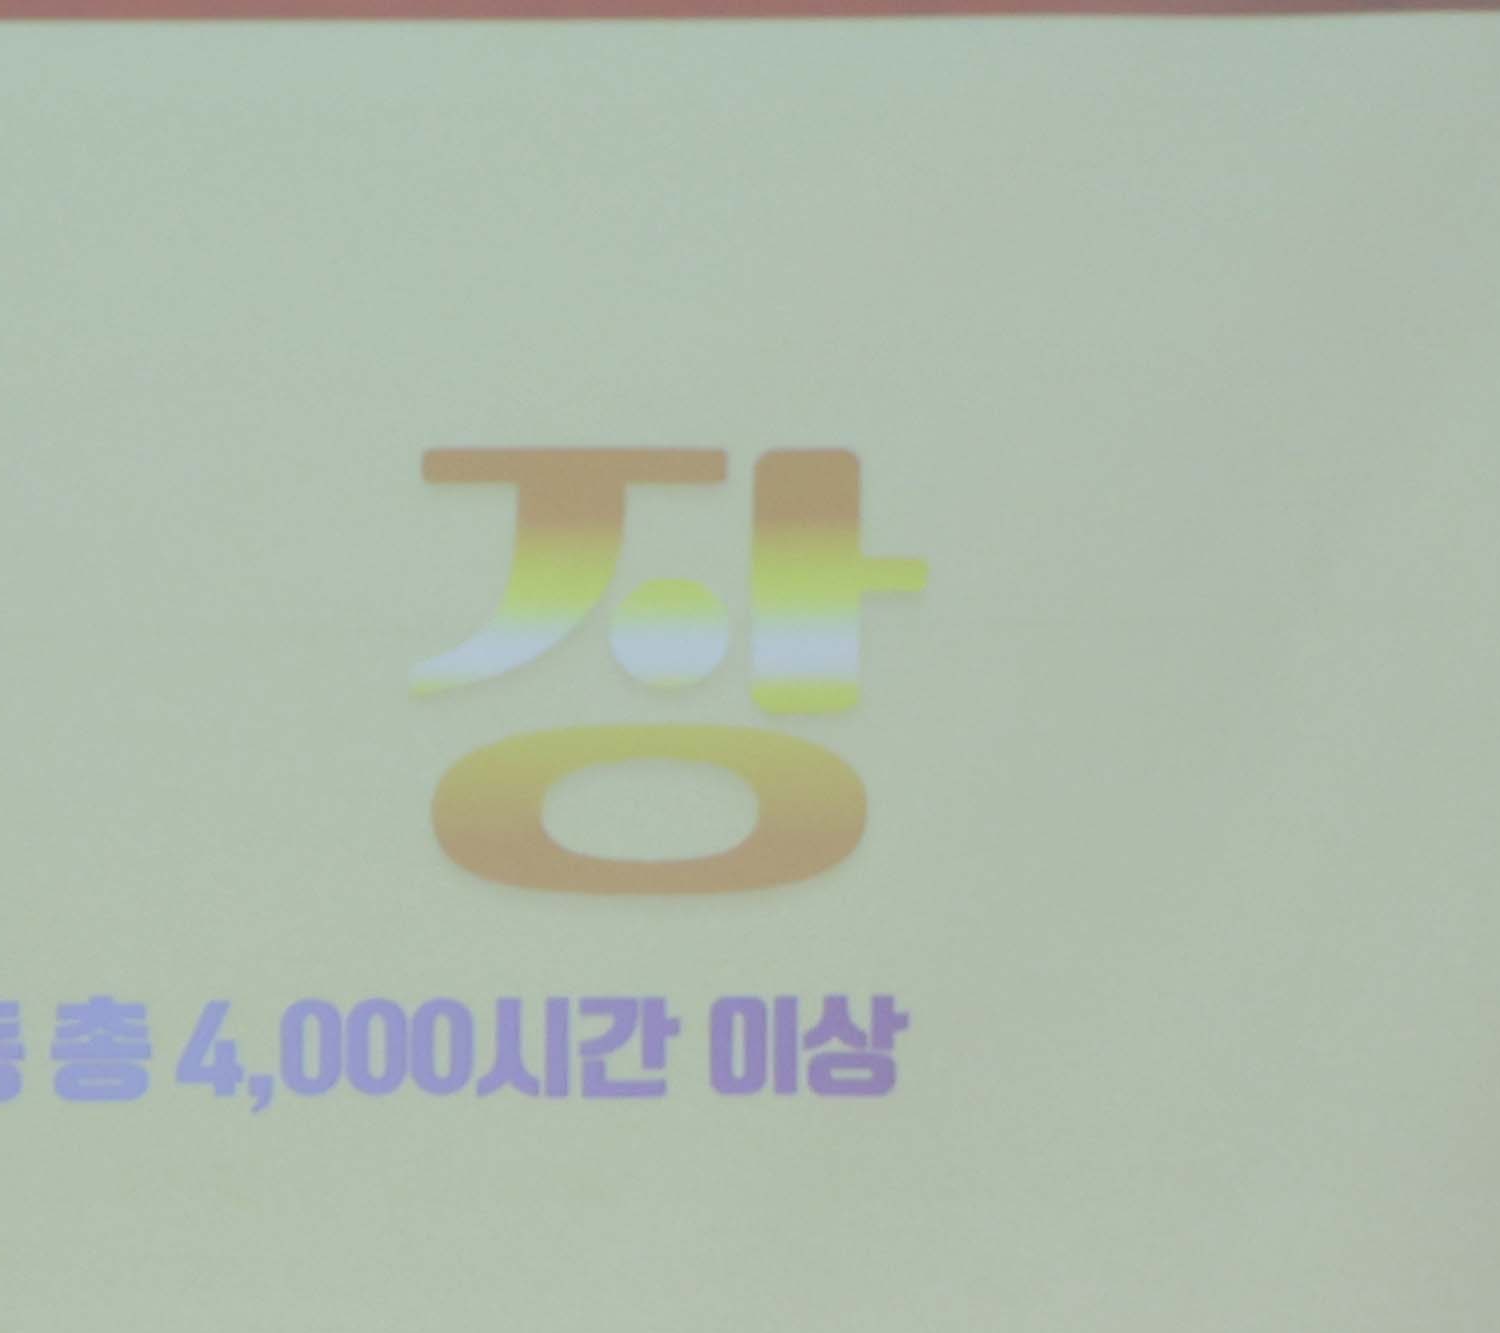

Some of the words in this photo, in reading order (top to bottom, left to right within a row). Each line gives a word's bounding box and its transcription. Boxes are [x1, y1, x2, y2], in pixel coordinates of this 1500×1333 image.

[409, 446, 931, 897] 장
[48, 994, 153, 1104] 총
[174, 992, 675, 1115] 4,000시간
[708, 993, 911, 1101] 이상
